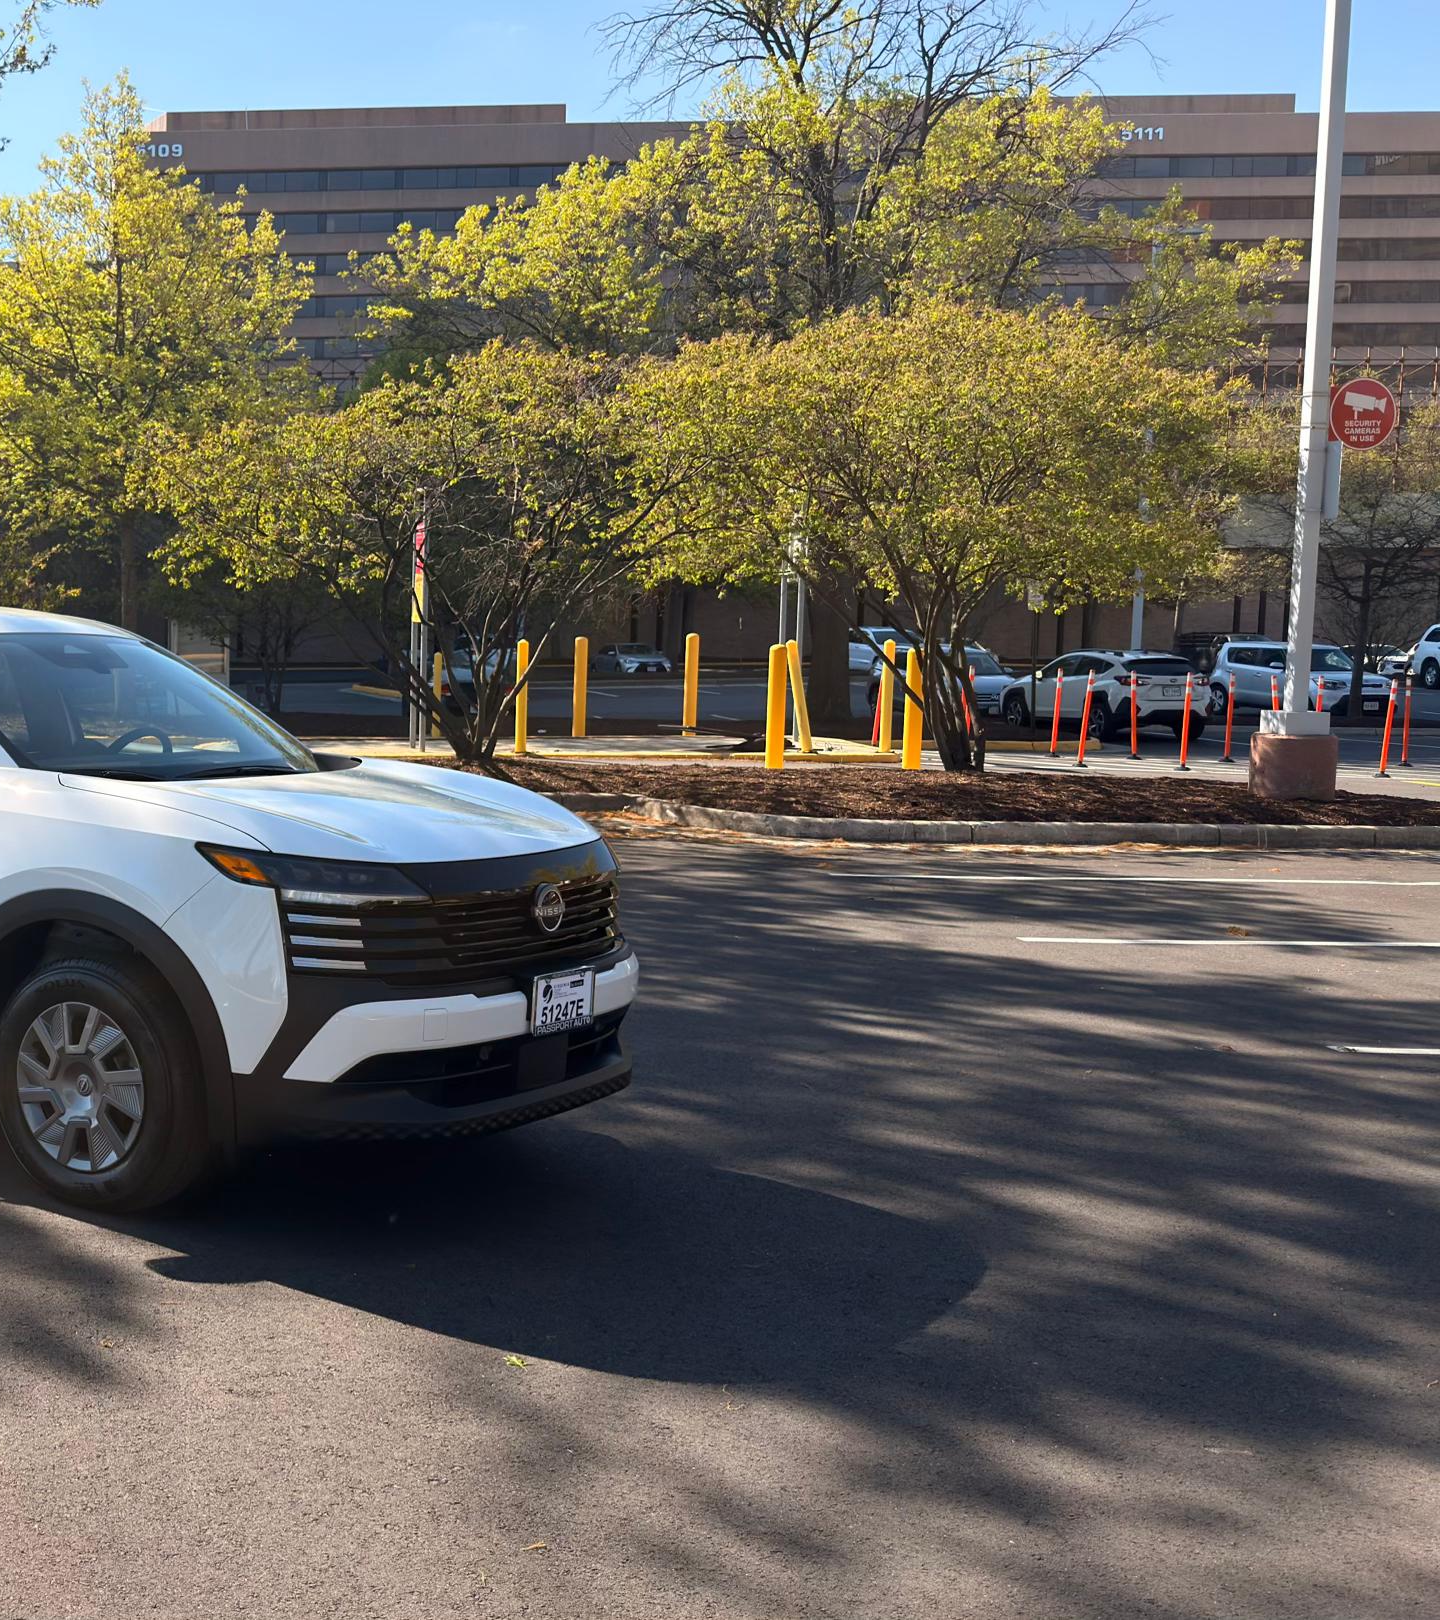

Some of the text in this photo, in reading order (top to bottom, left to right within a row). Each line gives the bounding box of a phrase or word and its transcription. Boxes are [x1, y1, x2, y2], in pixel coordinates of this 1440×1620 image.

[1121, 127, 1164, 141] 5111
[1344, 419, 1382, 427] SECURITY
[1344, 427, 1381, 435] CAMERAS
[541, 998, 585, 1025] 51247E
[537, 1016, 591, 1035] PASSPORT AUTO
